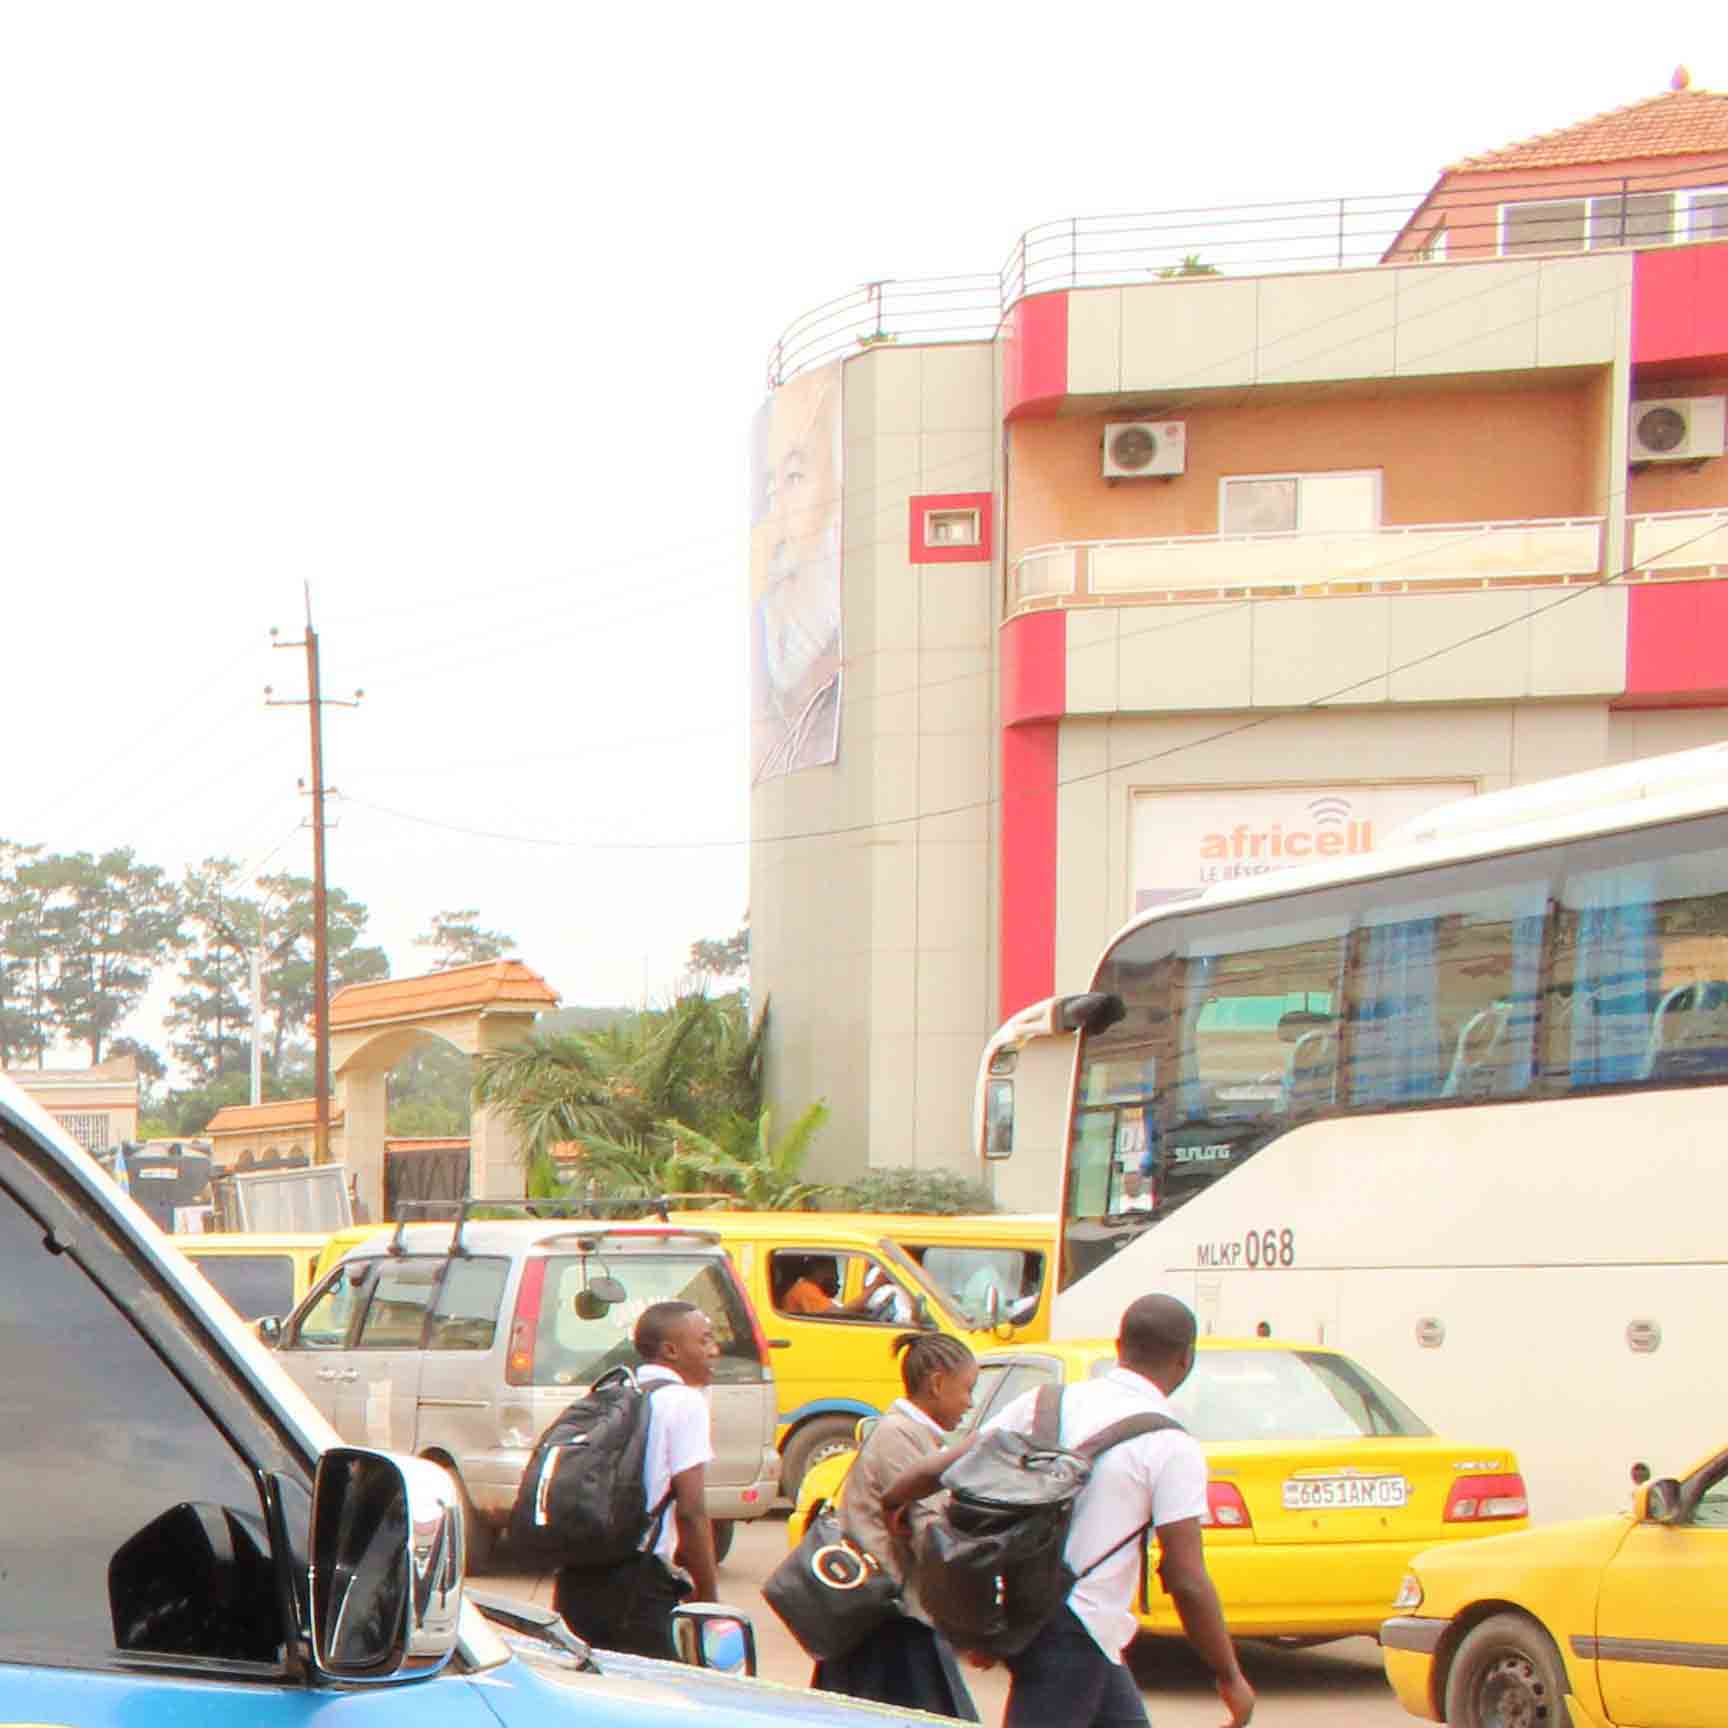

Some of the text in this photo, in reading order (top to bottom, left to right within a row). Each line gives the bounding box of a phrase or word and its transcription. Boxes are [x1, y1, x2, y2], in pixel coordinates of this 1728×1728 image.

[1199, 817, 1373, 860] africell
[1197, 1229, 1295, 1268] MLKP 068
